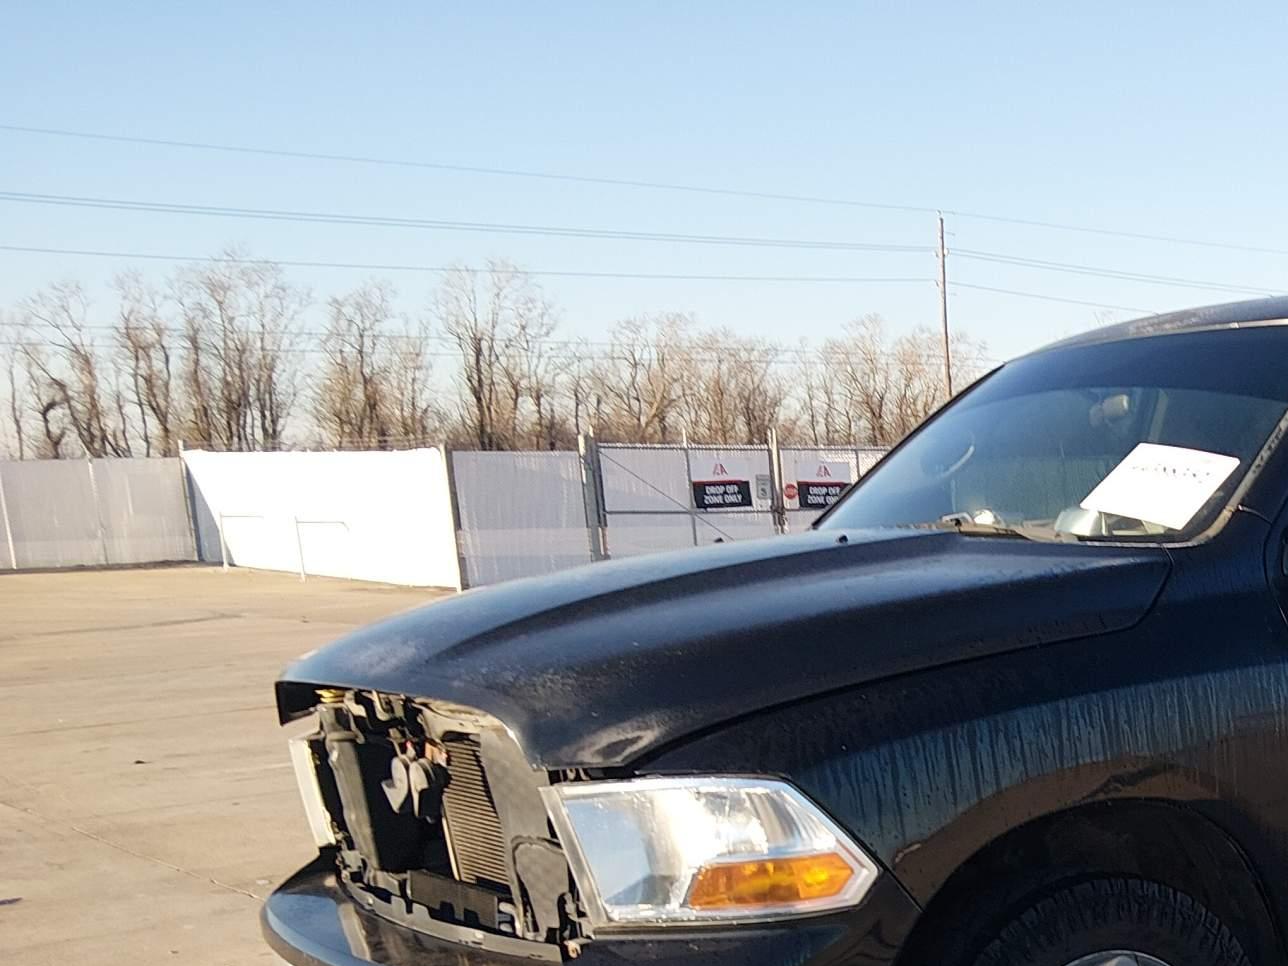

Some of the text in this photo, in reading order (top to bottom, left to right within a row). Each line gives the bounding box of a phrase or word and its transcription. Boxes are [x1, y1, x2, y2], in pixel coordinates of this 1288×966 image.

[704, 484, 739, 495] DROP OFF
[809, 486, 841, 495] DROP OFF
[703, 493, 743, 505] ZONE ONLY
[807, 495, 825, 505] ZONE
